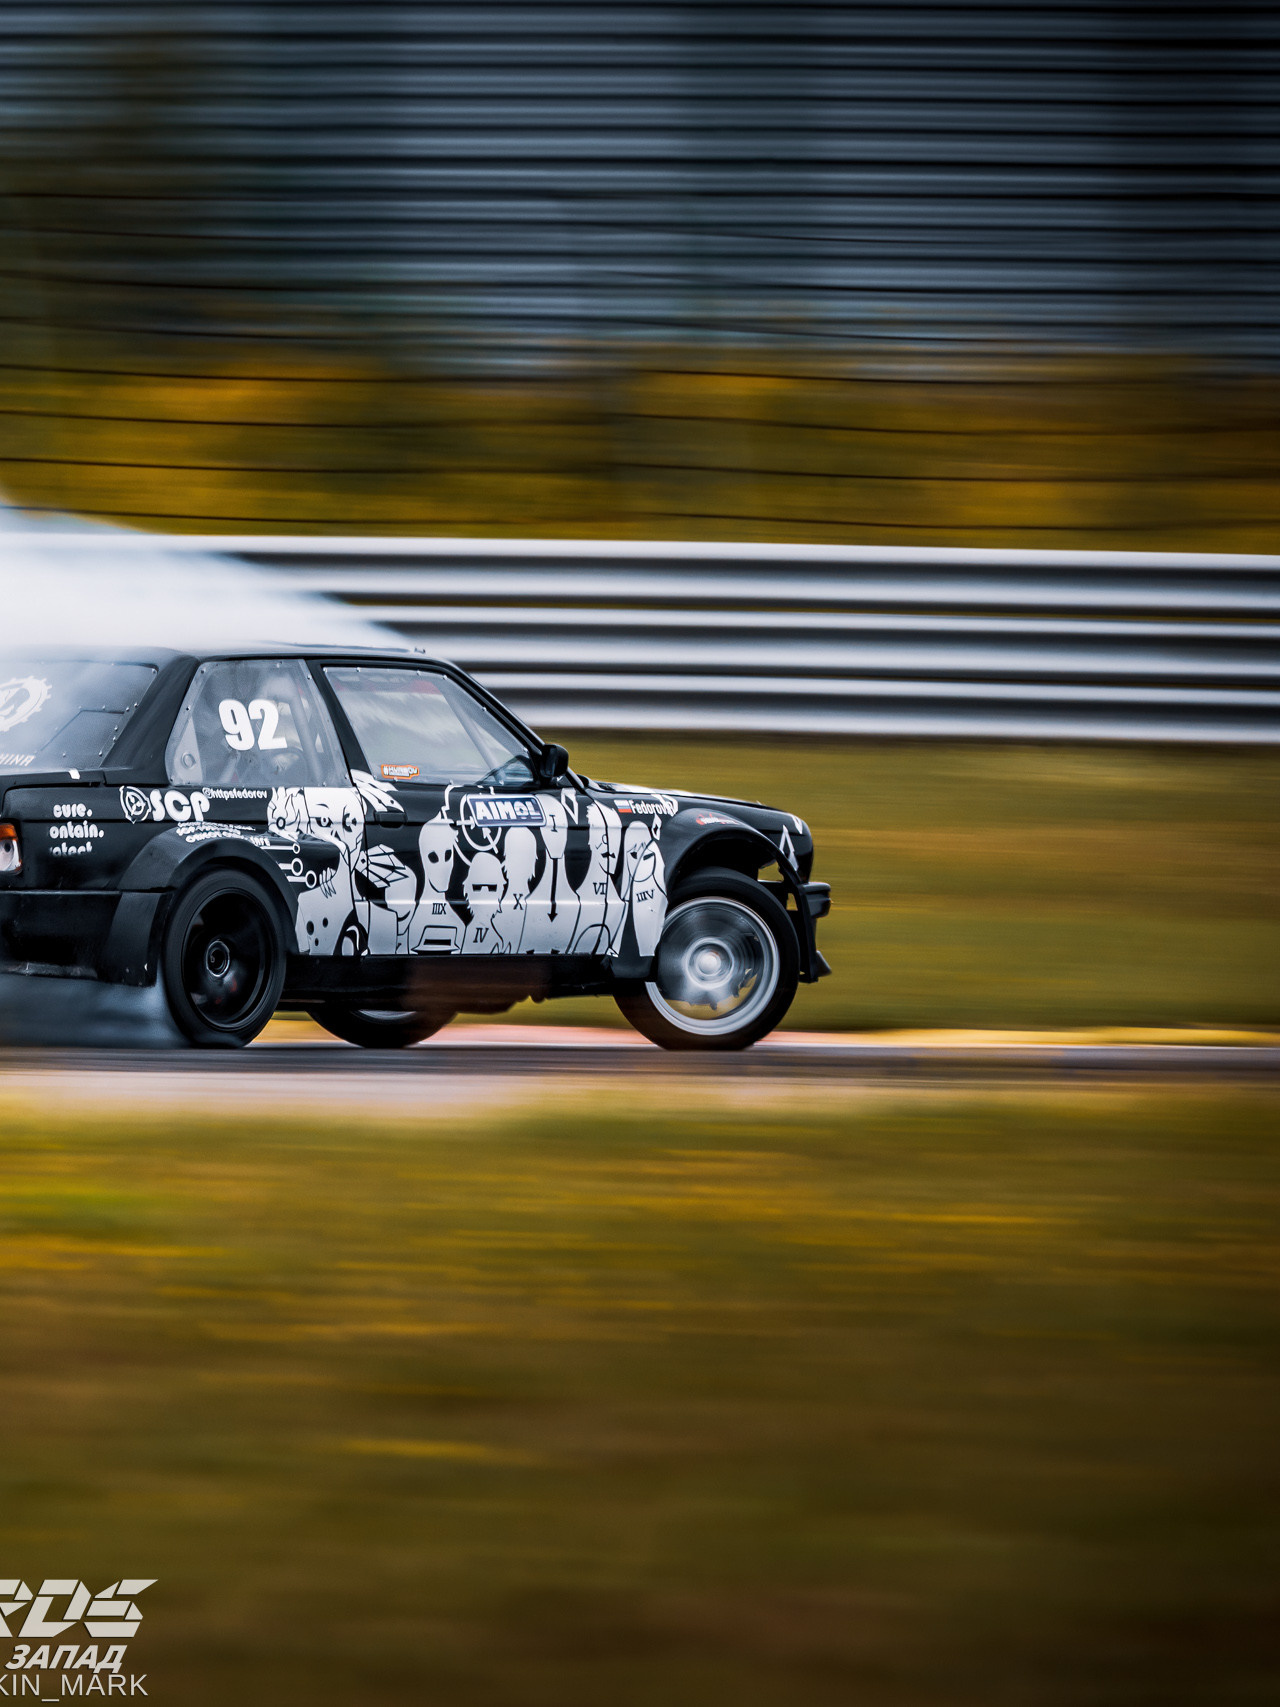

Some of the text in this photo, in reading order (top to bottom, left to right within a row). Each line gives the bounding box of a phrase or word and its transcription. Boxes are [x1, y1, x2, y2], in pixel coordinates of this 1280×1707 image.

[218, 699, 288, 751] 92
[150, 789, 210, 822] SCP
[475, 801, 542, 820] AIMOL
[49, 820, 104, 839] ontain.
[513, 894, 524, 910] X
[473, 928, 489, 943] IV
